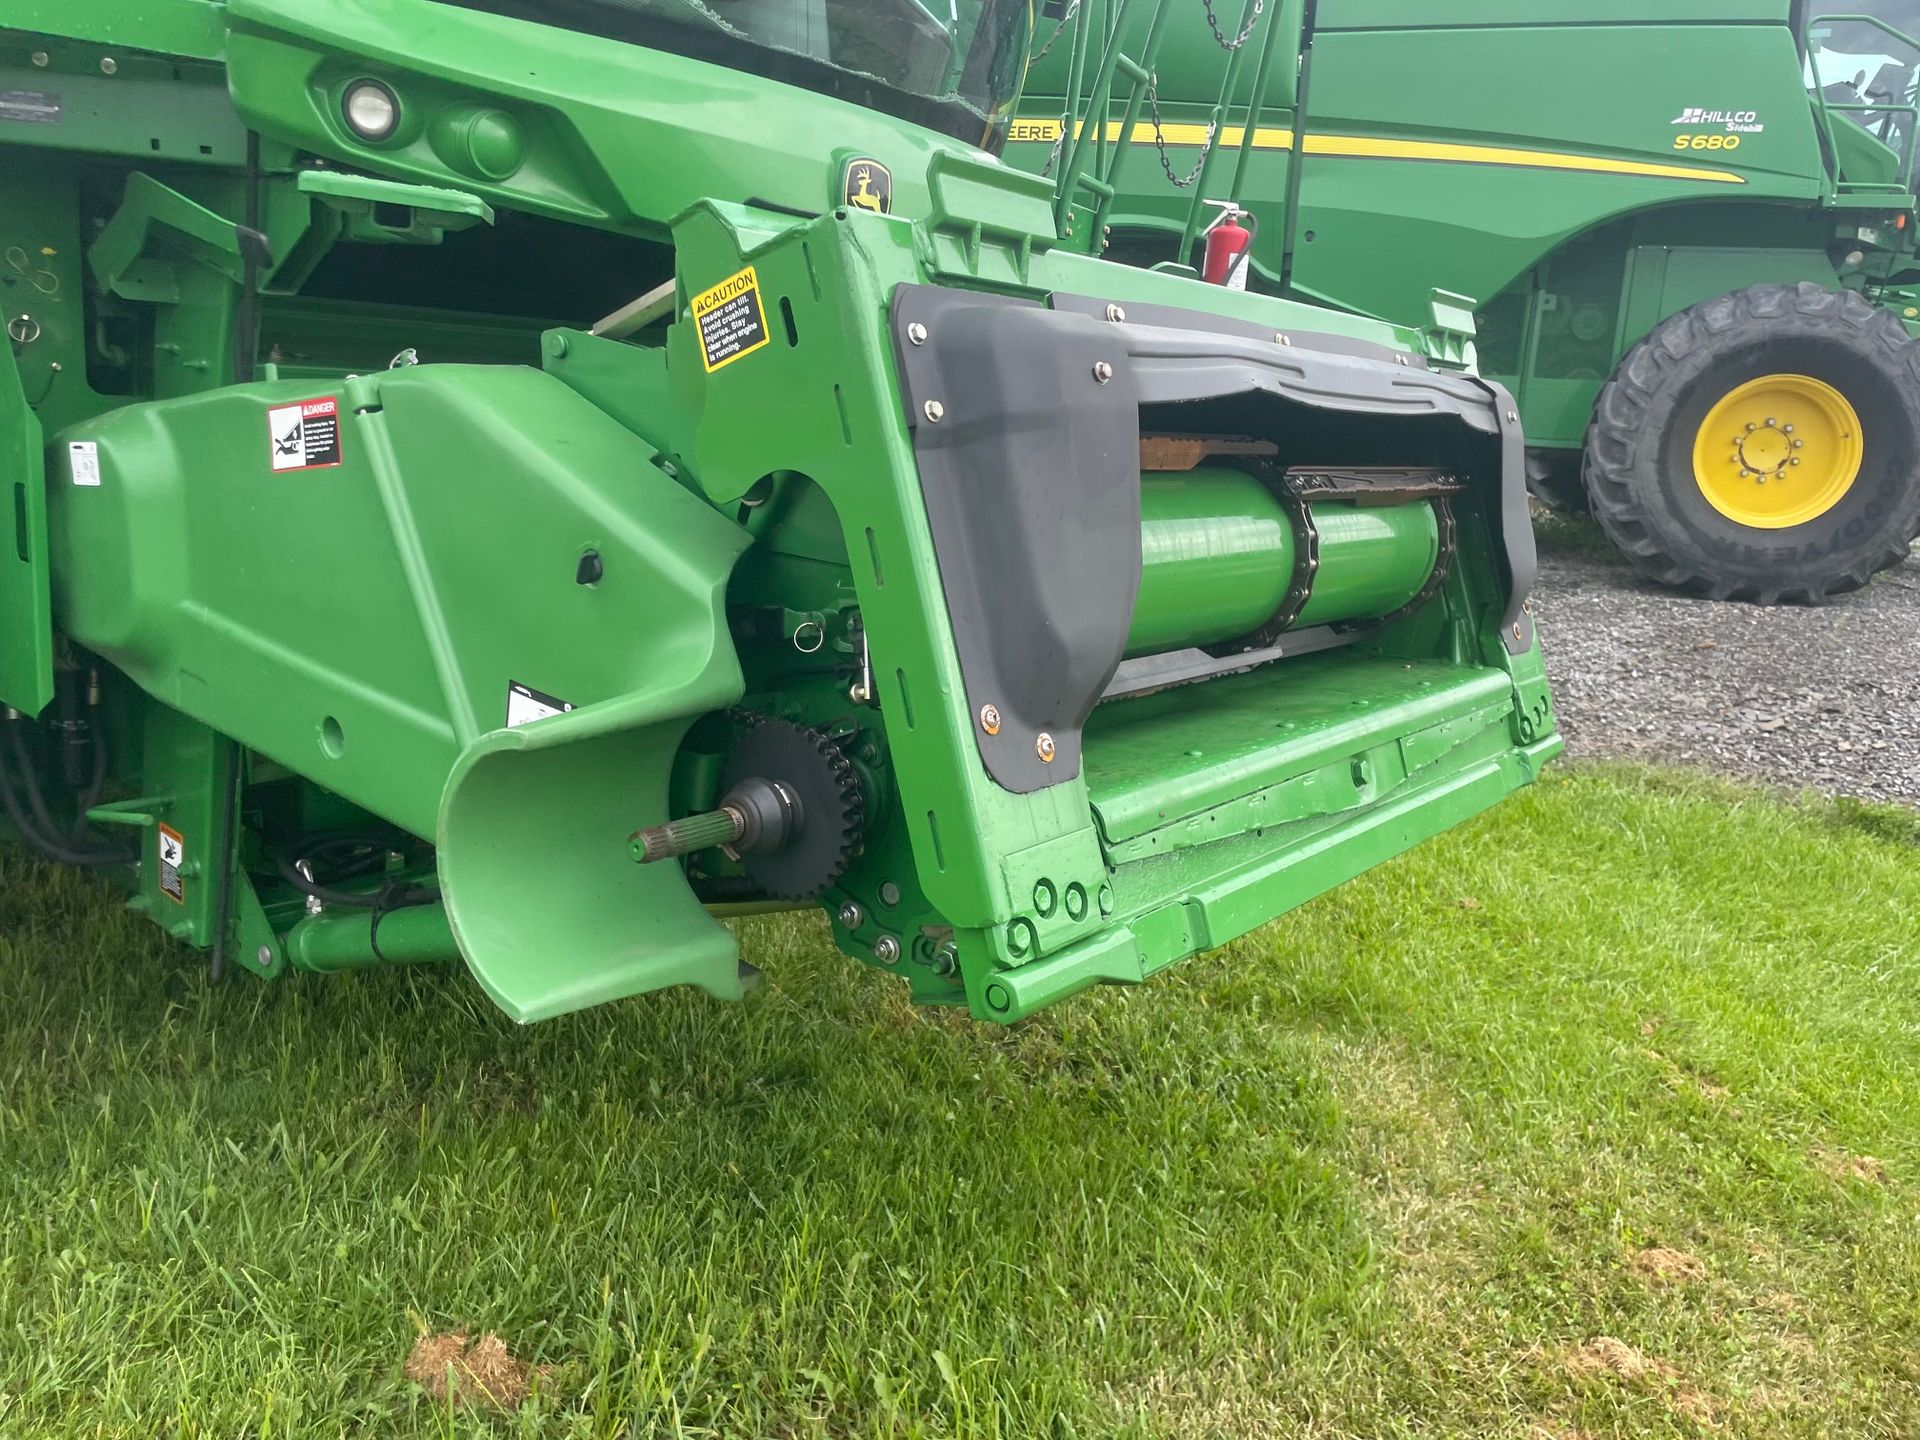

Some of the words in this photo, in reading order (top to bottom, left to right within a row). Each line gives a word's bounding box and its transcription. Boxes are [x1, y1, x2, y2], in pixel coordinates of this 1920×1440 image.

[1700, 111, 1756, 123] HILLCO
[1673, 134, 1740, 150] S680
[704, 272, 753, 308] CAUTION
[701, 309, 723, 326] Header
[724, 302, 737, 313] can
[704, 319, 721, 334] Avoid
[722, 305, 750, 324] crushing
[731, 318, 746, 330] Stay
[707, 340, 721, 352] clear
[722, 333, 738, 345] when
[737, 322, 758, 336] engine
[715, 341, 741, 359] running.
[309, 402, 335, 414] DANGER
